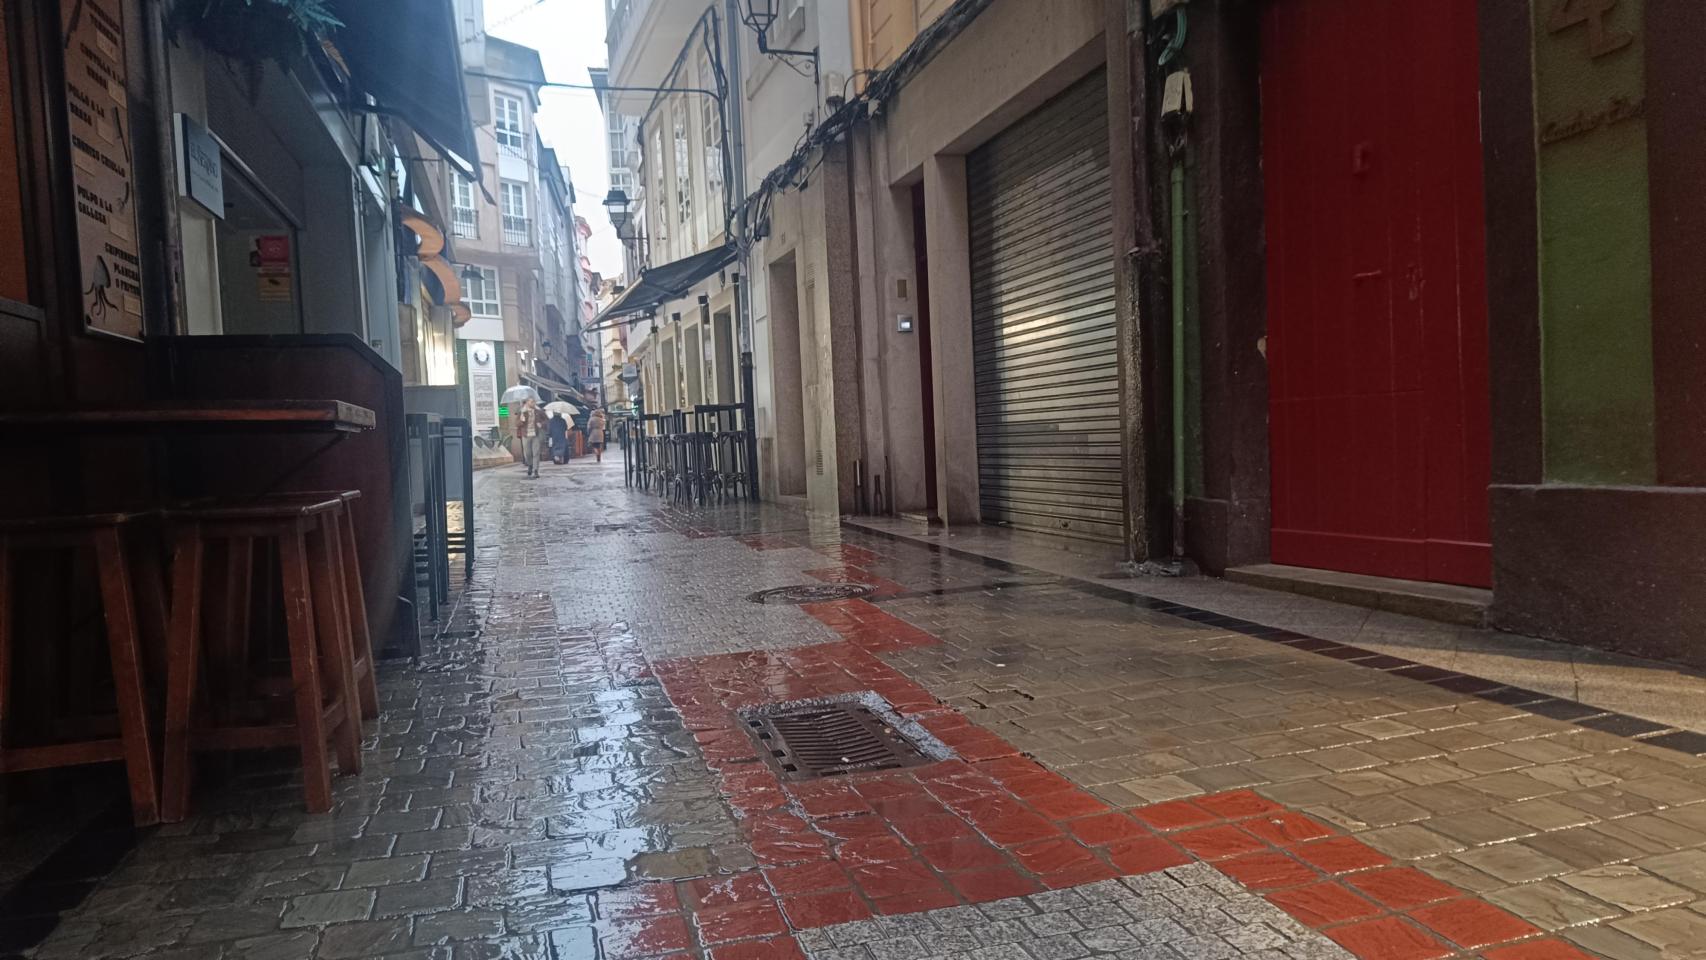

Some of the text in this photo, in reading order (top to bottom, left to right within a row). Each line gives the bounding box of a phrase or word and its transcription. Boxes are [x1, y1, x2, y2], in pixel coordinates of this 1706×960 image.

[96, 104, 104, 118] LA
[77, 185, 112, 213] PULPO A LA
[78, 202, 106, 225] GALLEGA
